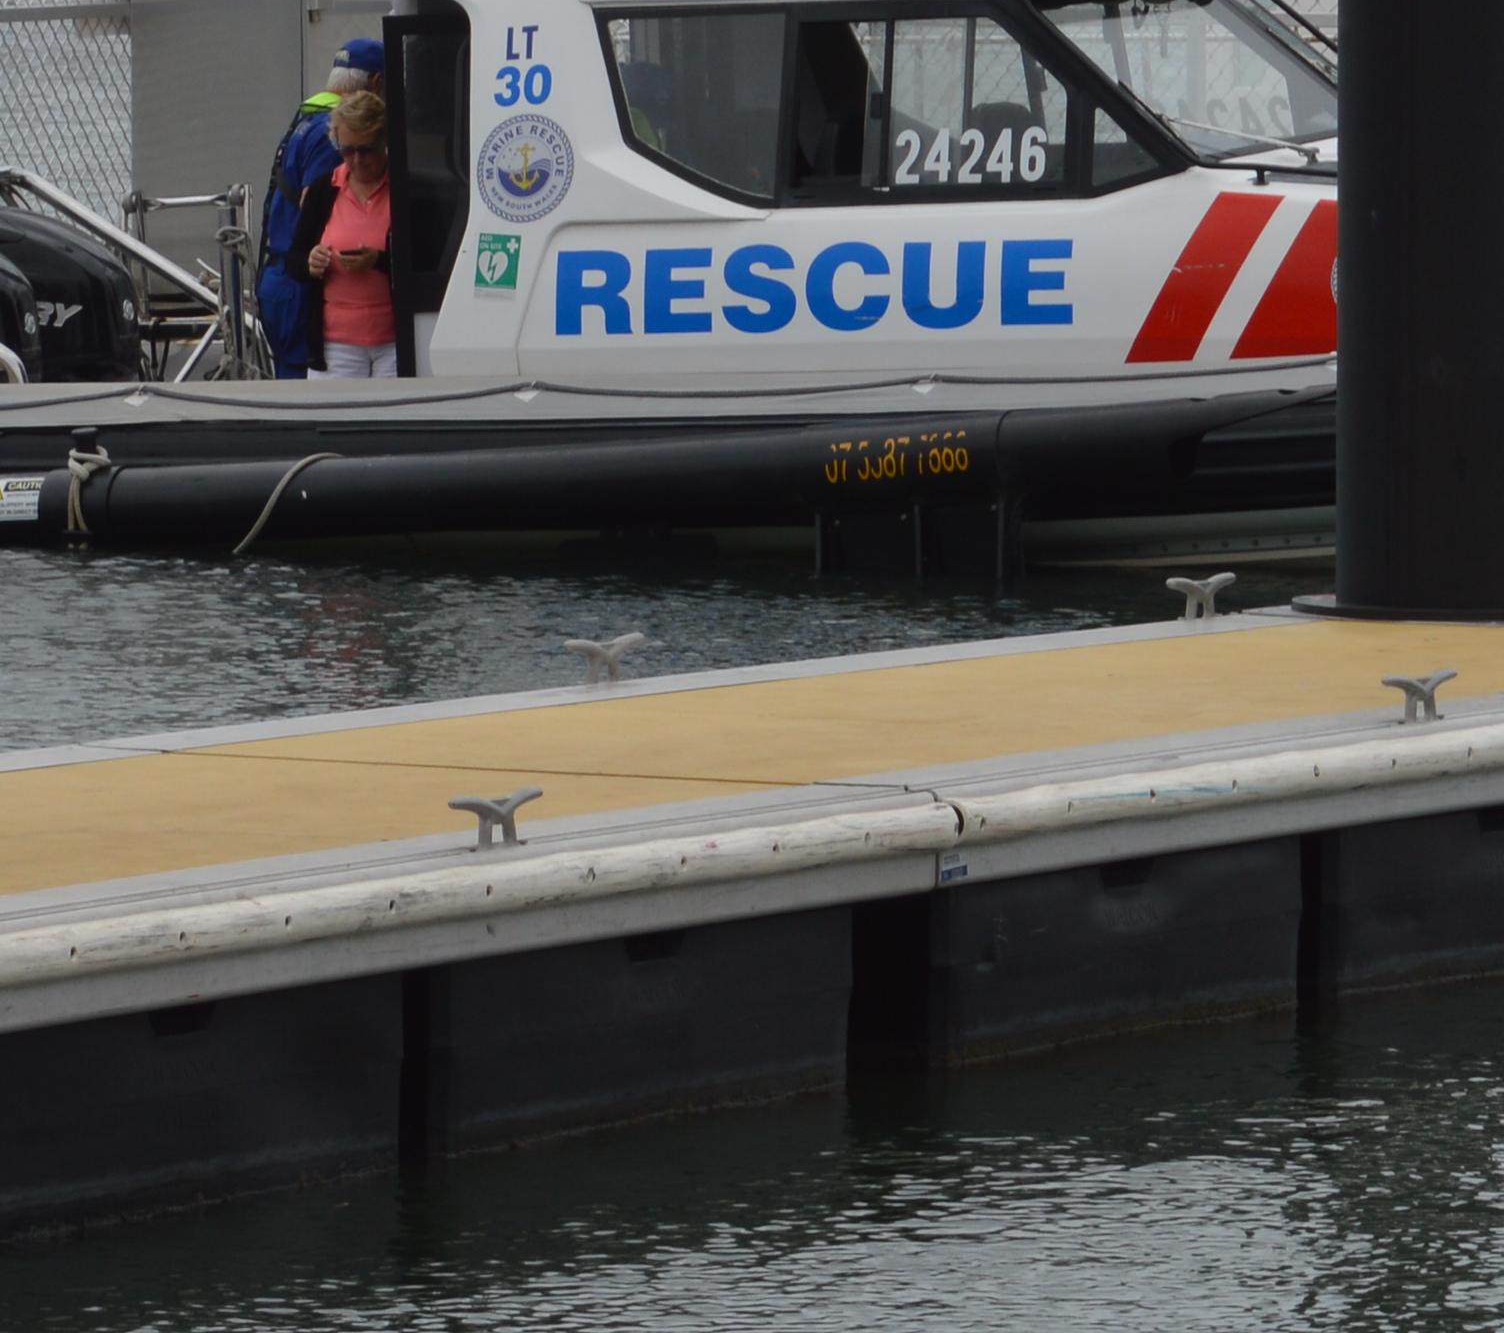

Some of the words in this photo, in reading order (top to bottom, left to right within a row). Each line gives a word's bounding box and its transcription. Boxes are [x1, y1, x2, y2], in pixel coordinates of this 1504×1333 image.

[506, 24, 539, 61] LT
[494, 64, 553, 107] 30
[485, 125, 524, 181] MARINE
[530, 125, 565, 178] RESCUE
[895, 126, 1047, 185] 24246
[506, 200, 533, 210] SOUTH
[554, 238, 1074, 335] RESCUE
